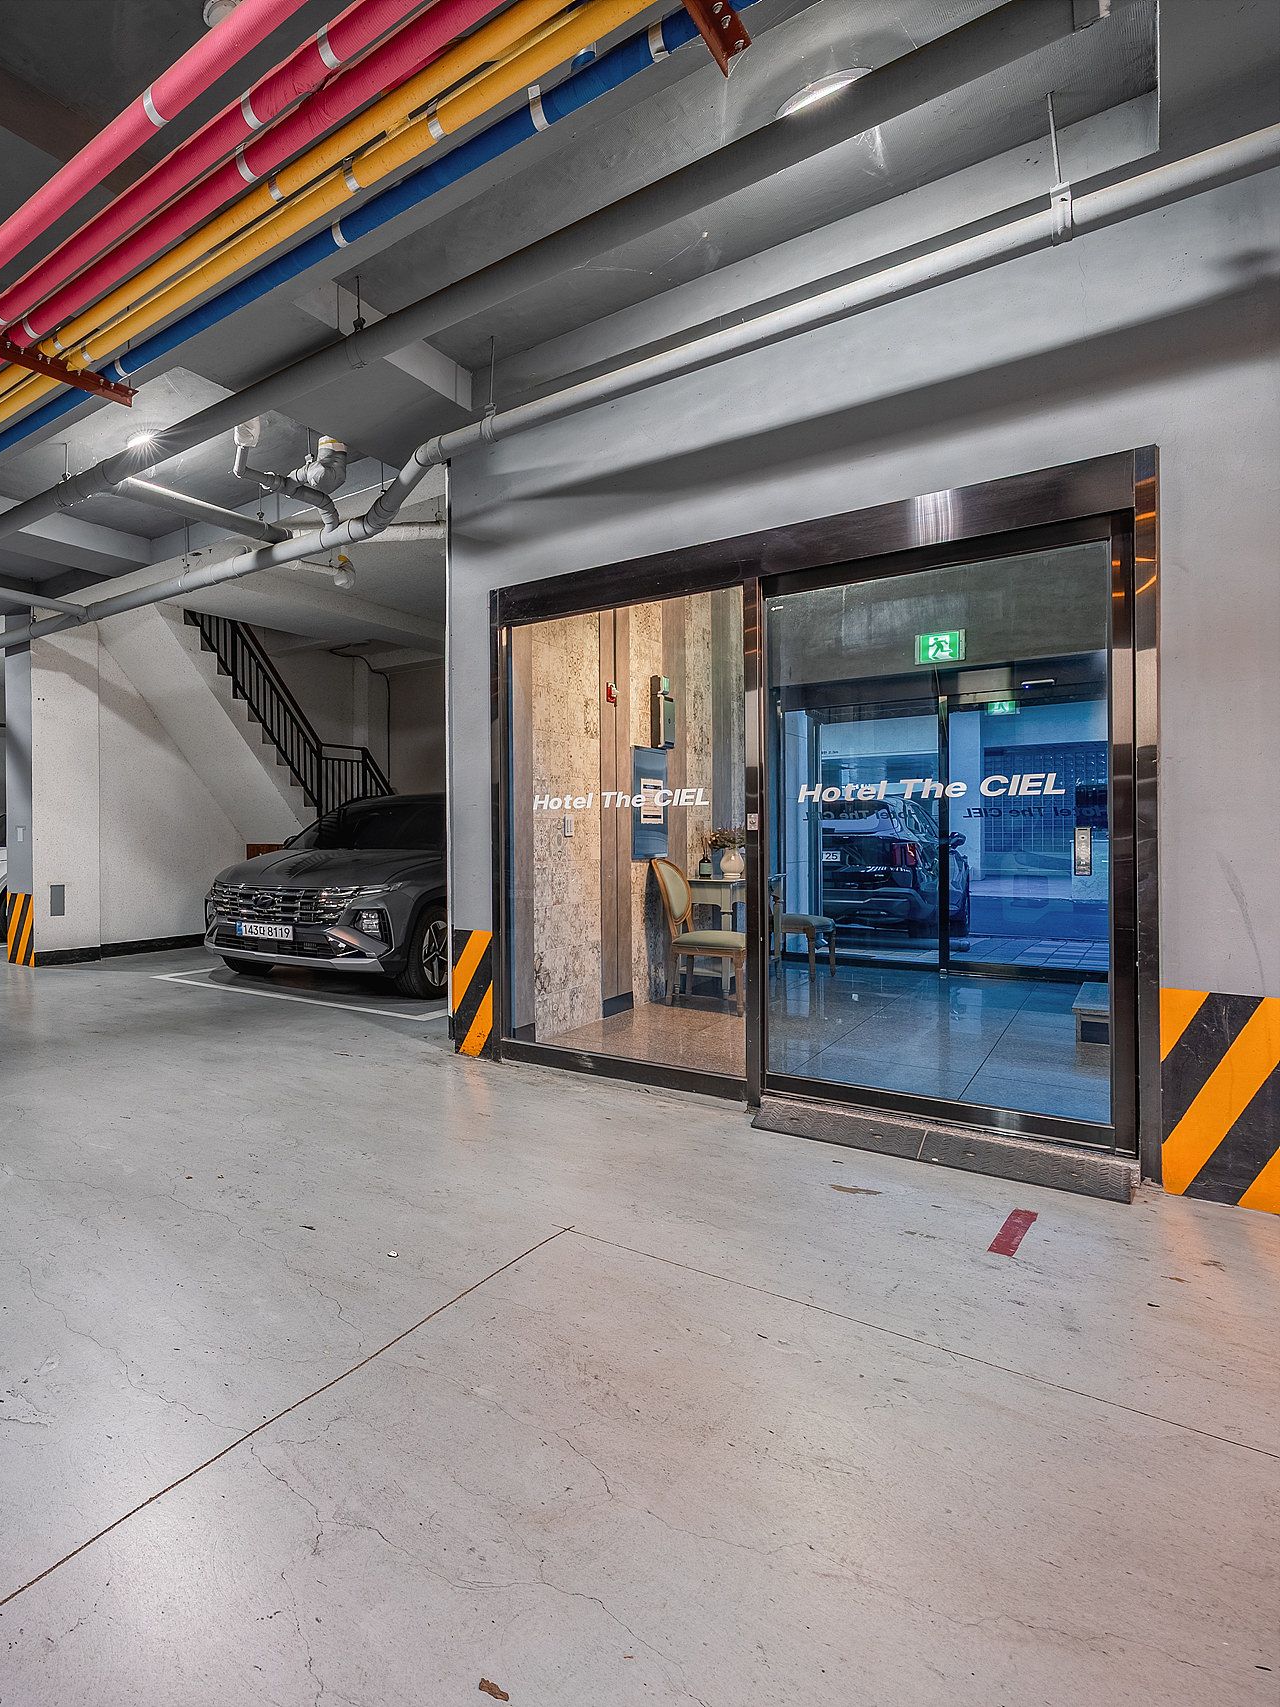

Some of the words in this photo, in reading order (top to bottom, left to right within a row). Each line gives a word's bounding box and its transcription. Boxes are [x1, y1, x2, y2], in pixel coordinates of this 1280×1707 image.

[533, 792, 593, 810] Hotel
[601, 791, 646, 808] The
[654, 788, 710, 807] CIEL
[798, 780, 888, 803] Hotel
[900, 778, 967, 799] The
[980, 773, 1066, 797] CIEL
[243, 924, 266, 936] 143다
[267, 926, 291, 939] 8119
